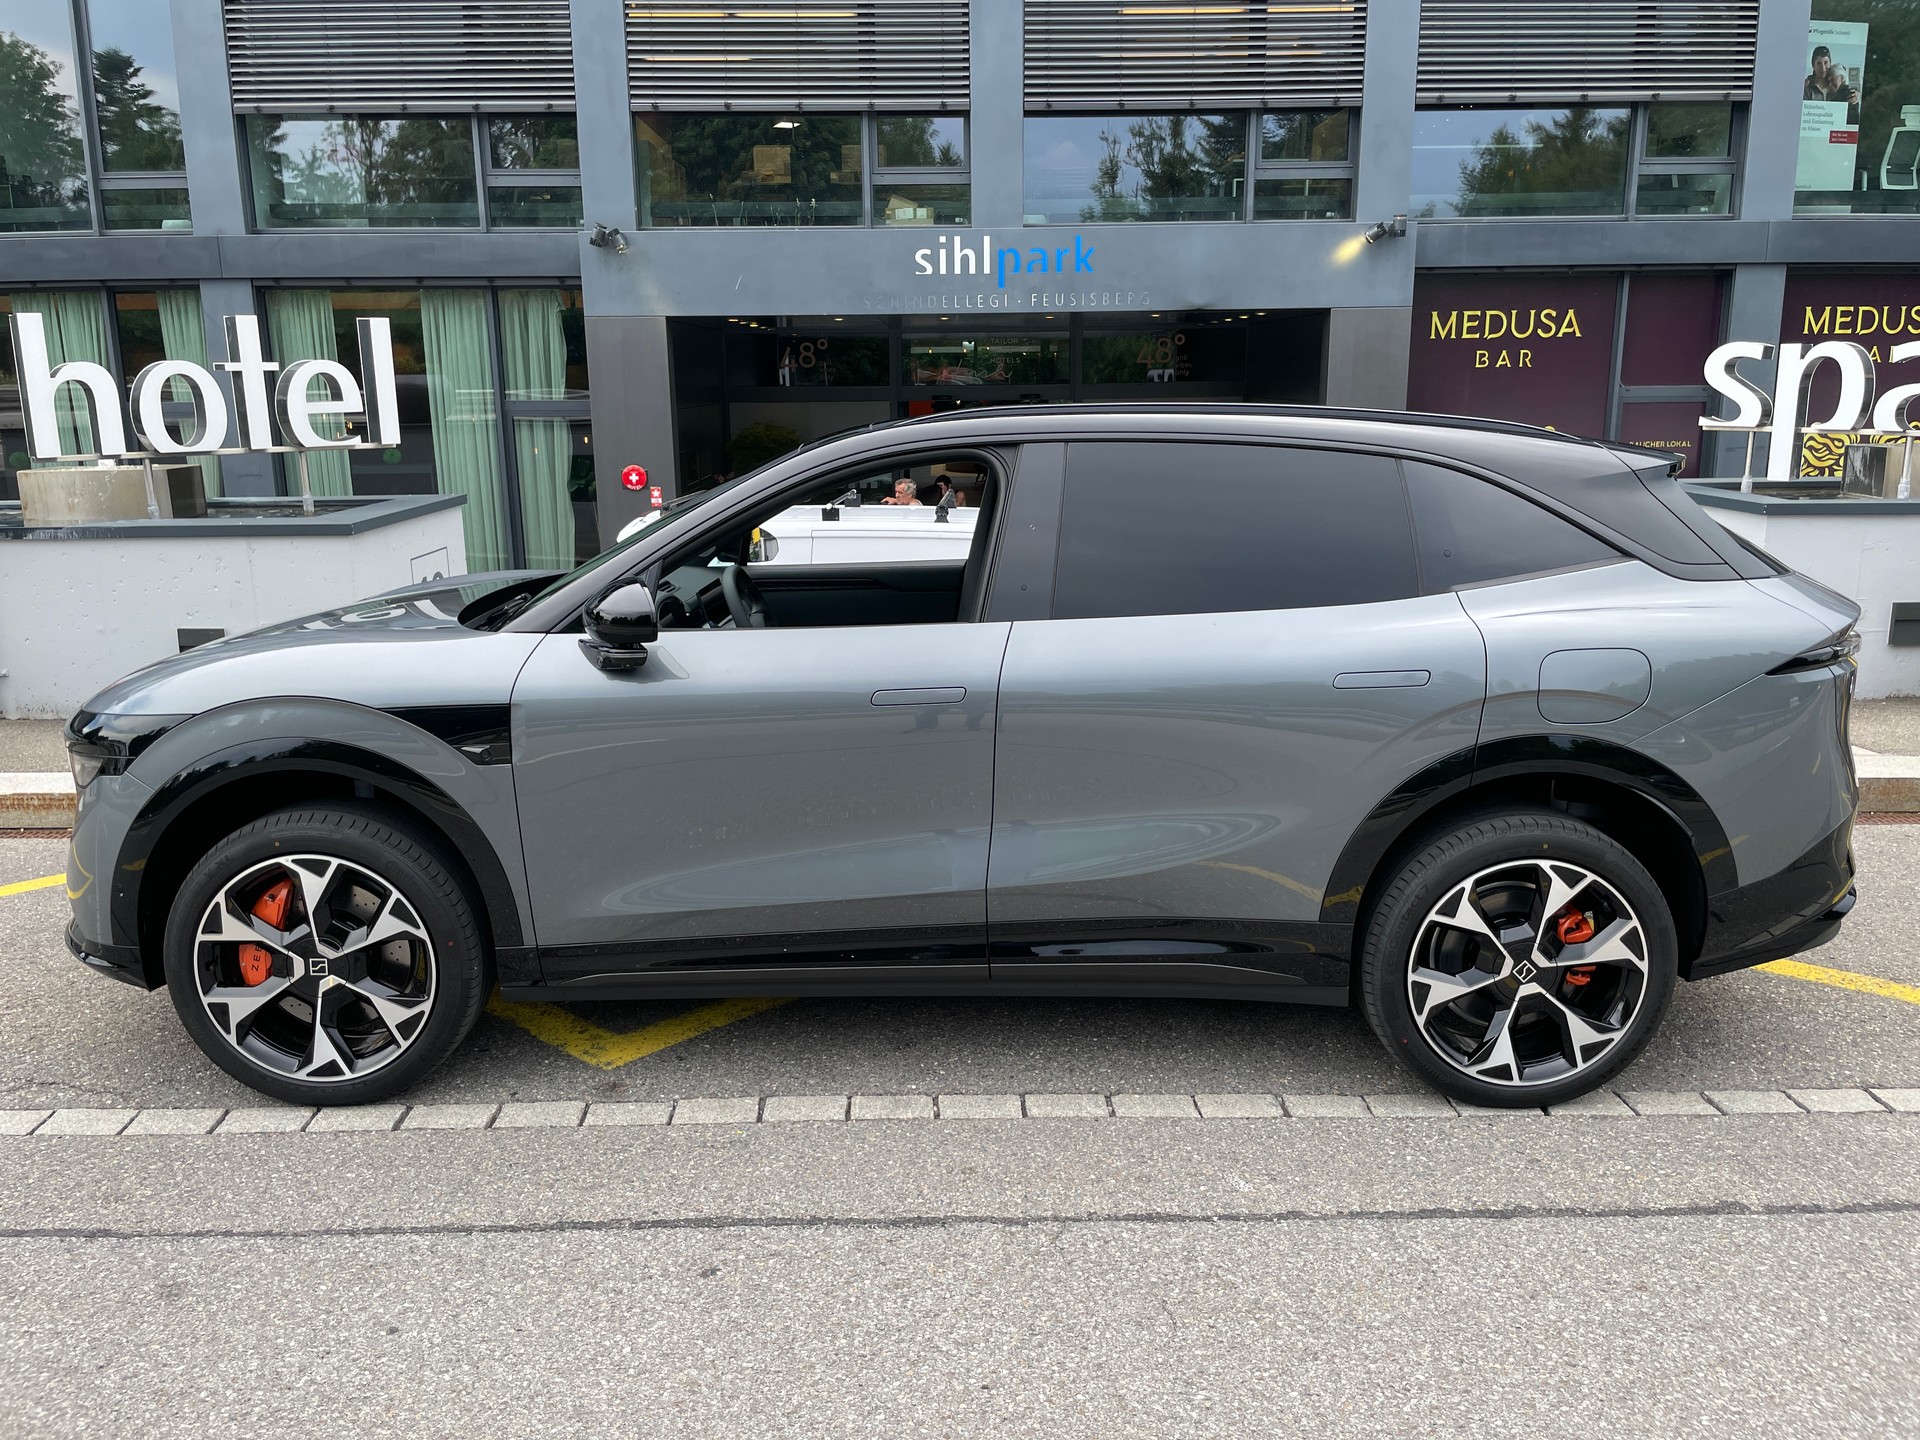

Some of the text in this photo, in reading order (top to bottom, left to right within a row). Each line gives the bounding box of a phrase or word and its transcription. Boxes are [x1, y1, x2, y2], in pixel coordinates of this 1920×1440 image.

[914, 235, 1096, 289] sihlpark
[863, 292, 1151, 310] SCHINDELLEGI FEUSISBERG
[1430, 309, 1582, 340] MEDUSA
[1475, 349, 1532, 368] BAR
[8, 312, 401, 459] hotel
[1698, 341, 1920, 481] spa
